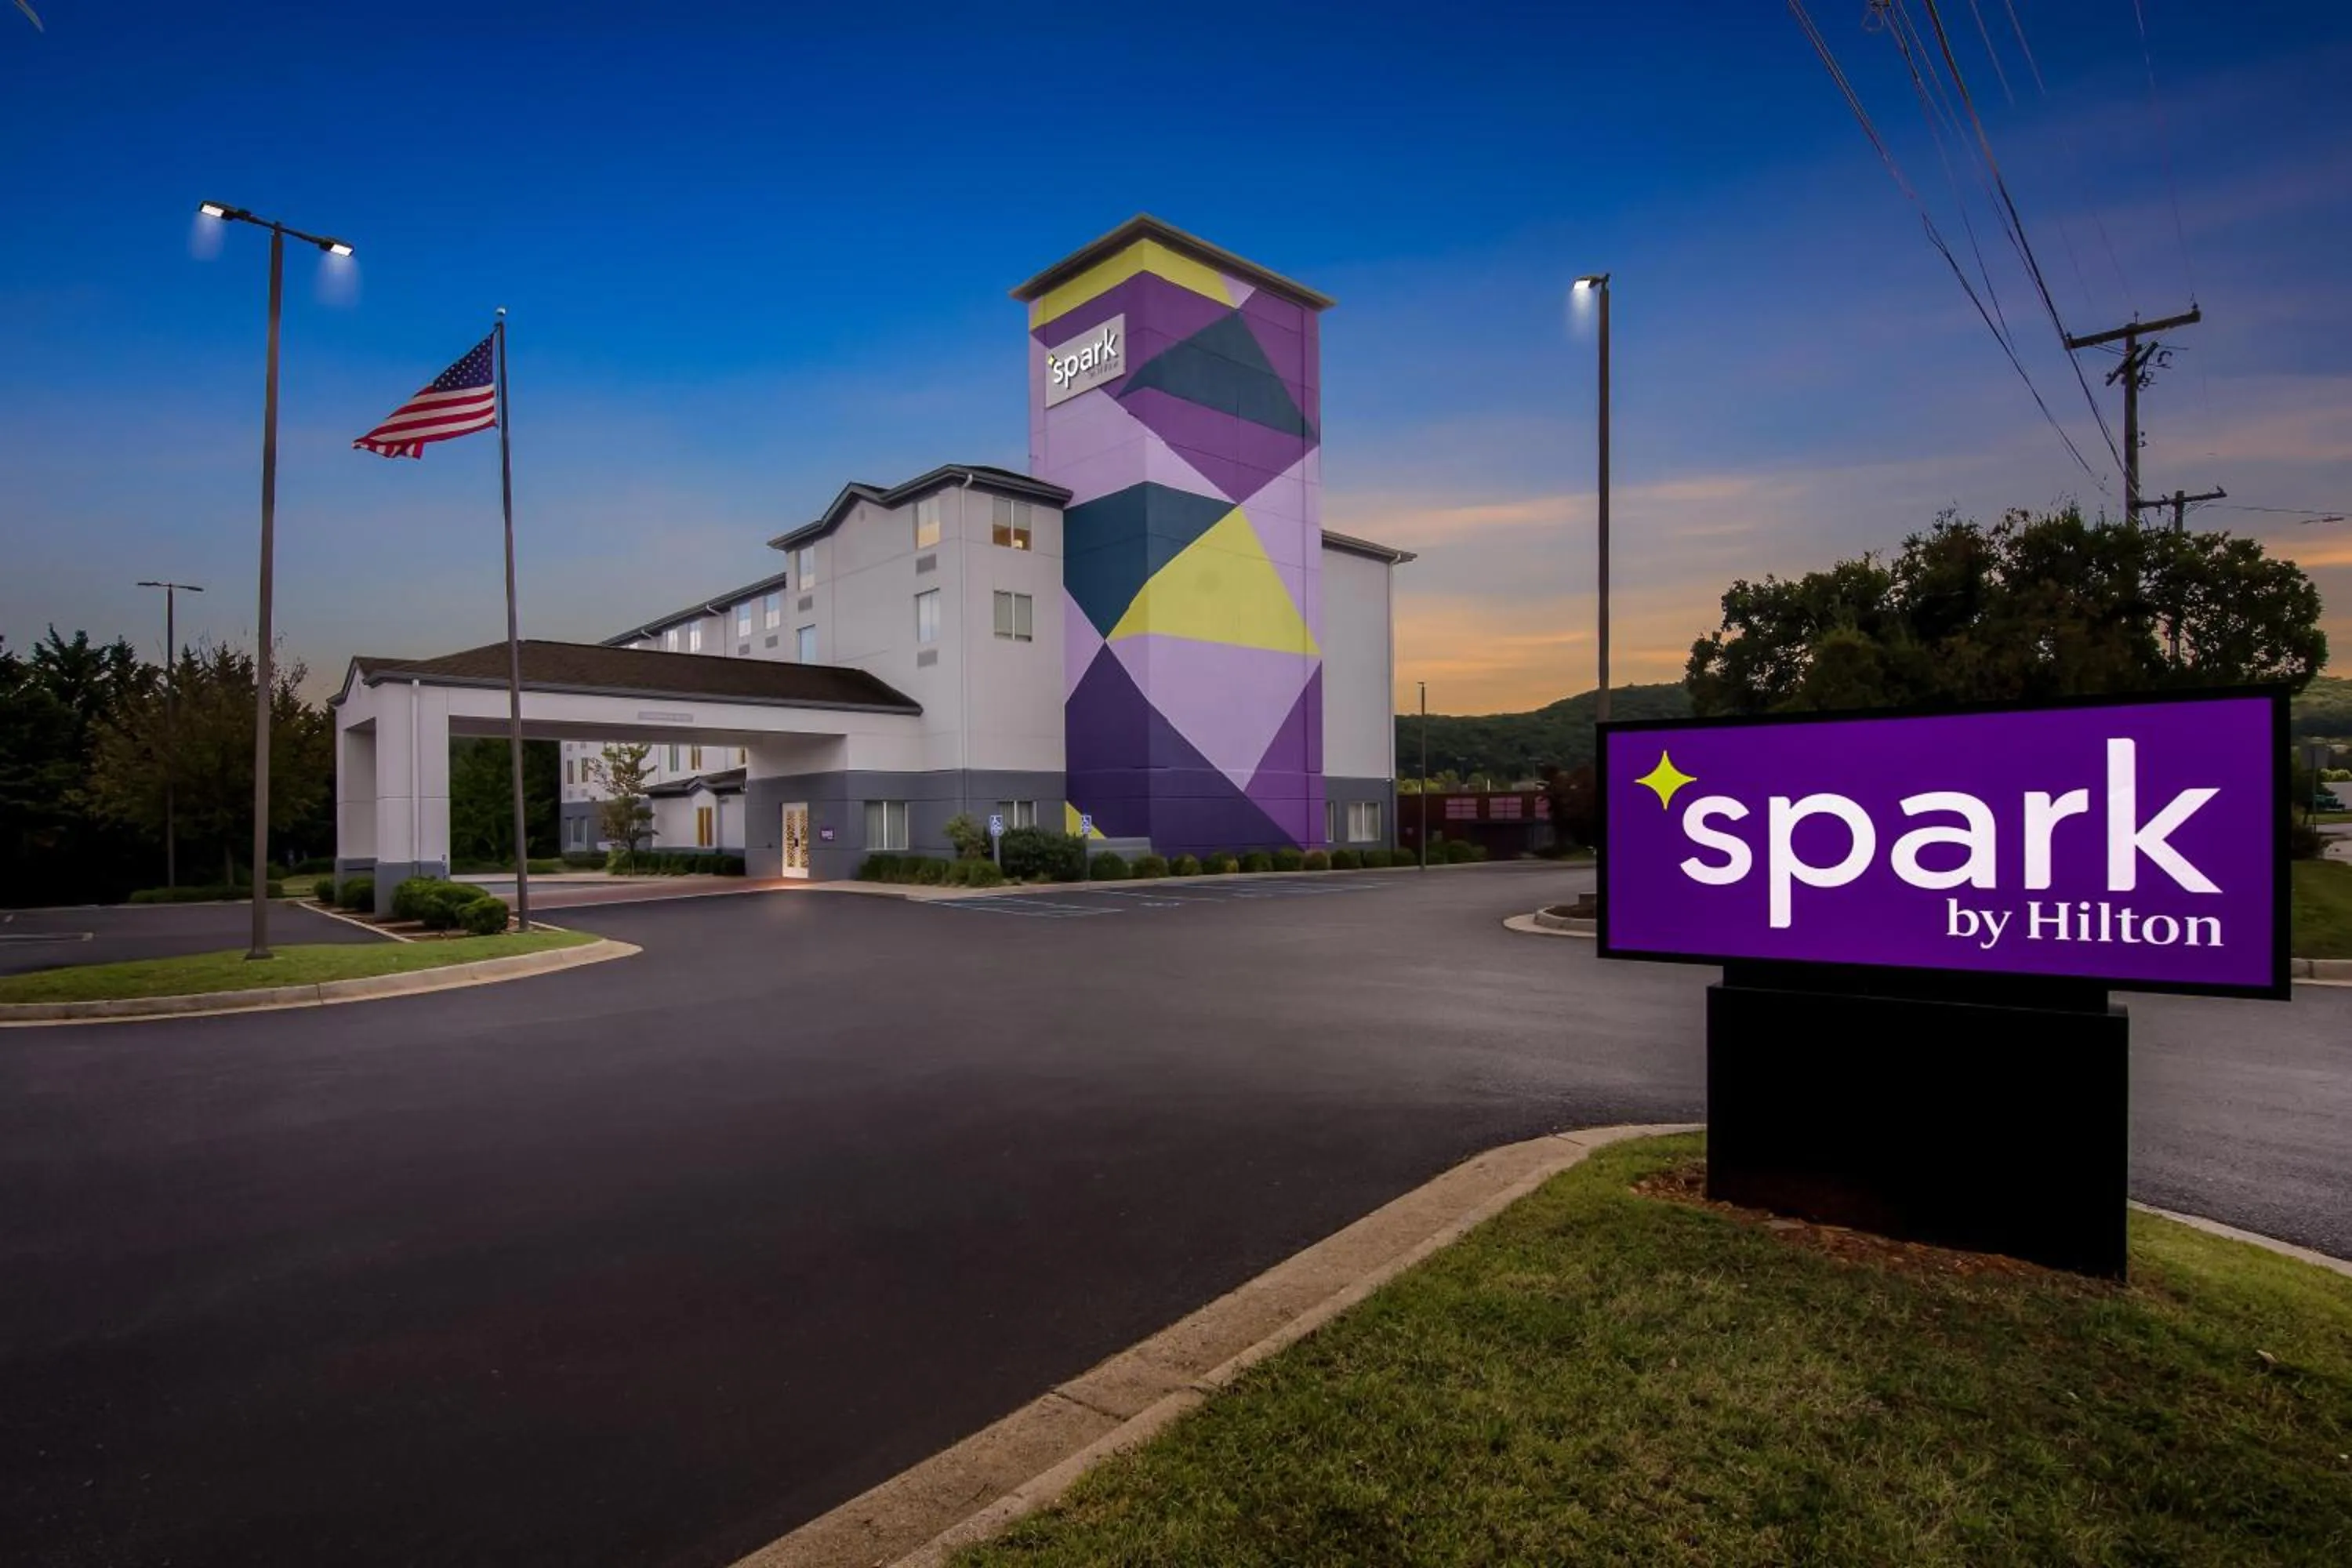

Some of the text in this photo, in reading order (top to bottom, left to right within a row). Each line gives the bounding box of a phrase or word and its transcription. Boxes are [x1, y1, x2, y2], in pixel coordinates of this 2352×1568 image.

[1053, 328, 1117, 388] spark
[1679, 738, 2223, 929] spark
[1947, 898, 2224, 949] by Hilton
